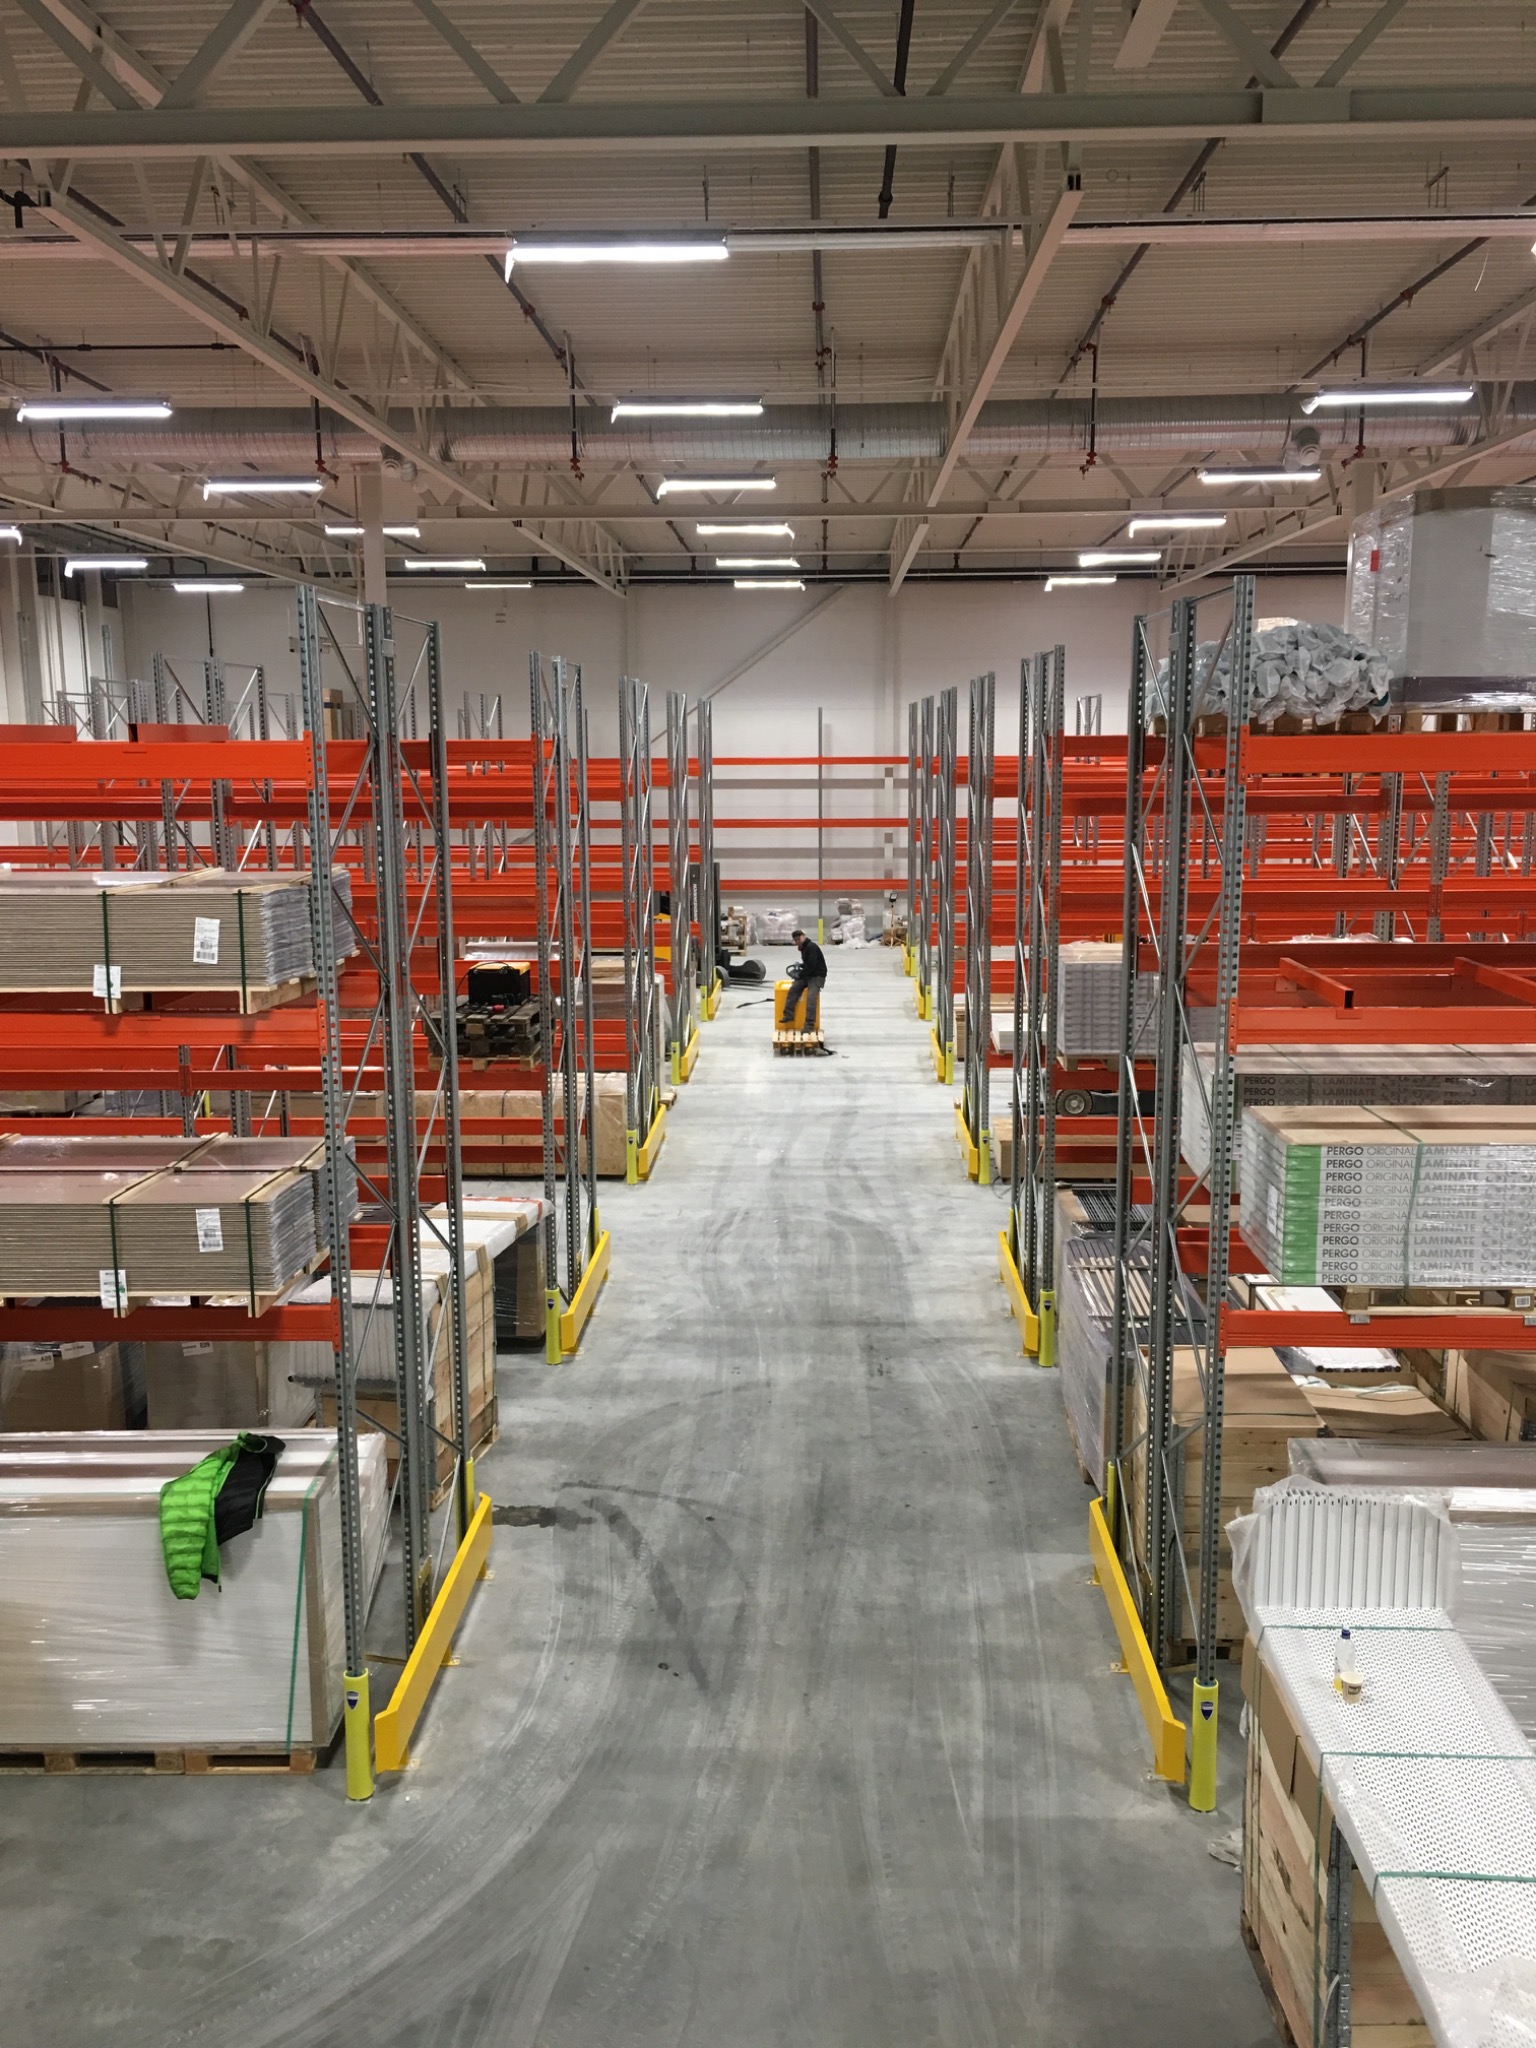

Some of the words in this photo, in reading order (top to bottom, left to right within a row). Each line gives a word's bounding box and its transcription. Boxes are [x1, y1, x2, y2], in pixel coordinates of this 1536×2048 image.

[1244, 1076, 1276, 1085] PERGO
[1322, 1077, 1376, 1085] LAMINATE
[1244, 1087, 1275, 1096] PERGO
[1322, 1088, 1376, 1096] LAMINATE
[1326, 1146, 1364, 1156] PERGO
[1366, 1146, 1416, 1156] ORIGINAL
[1326, 1160, 1363, 1168] PERGO
[1366, 1160, 1415, 1168] ORIGINAL
[1326, 1172, 1362, 1181] PERGO
[1366, 1172, 1414, 1181] ORIGINAL
[1325, 1185, 1362, 1194] PERGO
[1324, 1198, 1361, 1206] PERGO
[1364, 1198, 1412, 1206] ORIGINA
[1324, 1210, 1360, 1220] PERGO
[1364, 1210, 1411, 1220] ORIGINA
[1324, 1224, 1360, 1232] PERGO
[1322, 1236, 1359, 1246] PERGO
[1414, 1236, 1474, 1246] LAMINATE
[1322, 1249, 1358, 1258] PERGO
[1362, 1249, 1408, 1258] ORIGINA
[1414, 1249, 1474, 1258] LAMINATE
[1322, 1262, 1358, 1271] PERGO
[1322, 1274, 1358, 1284] PERGO
[1361, 1274, 1408, 1284] ORIGINA
